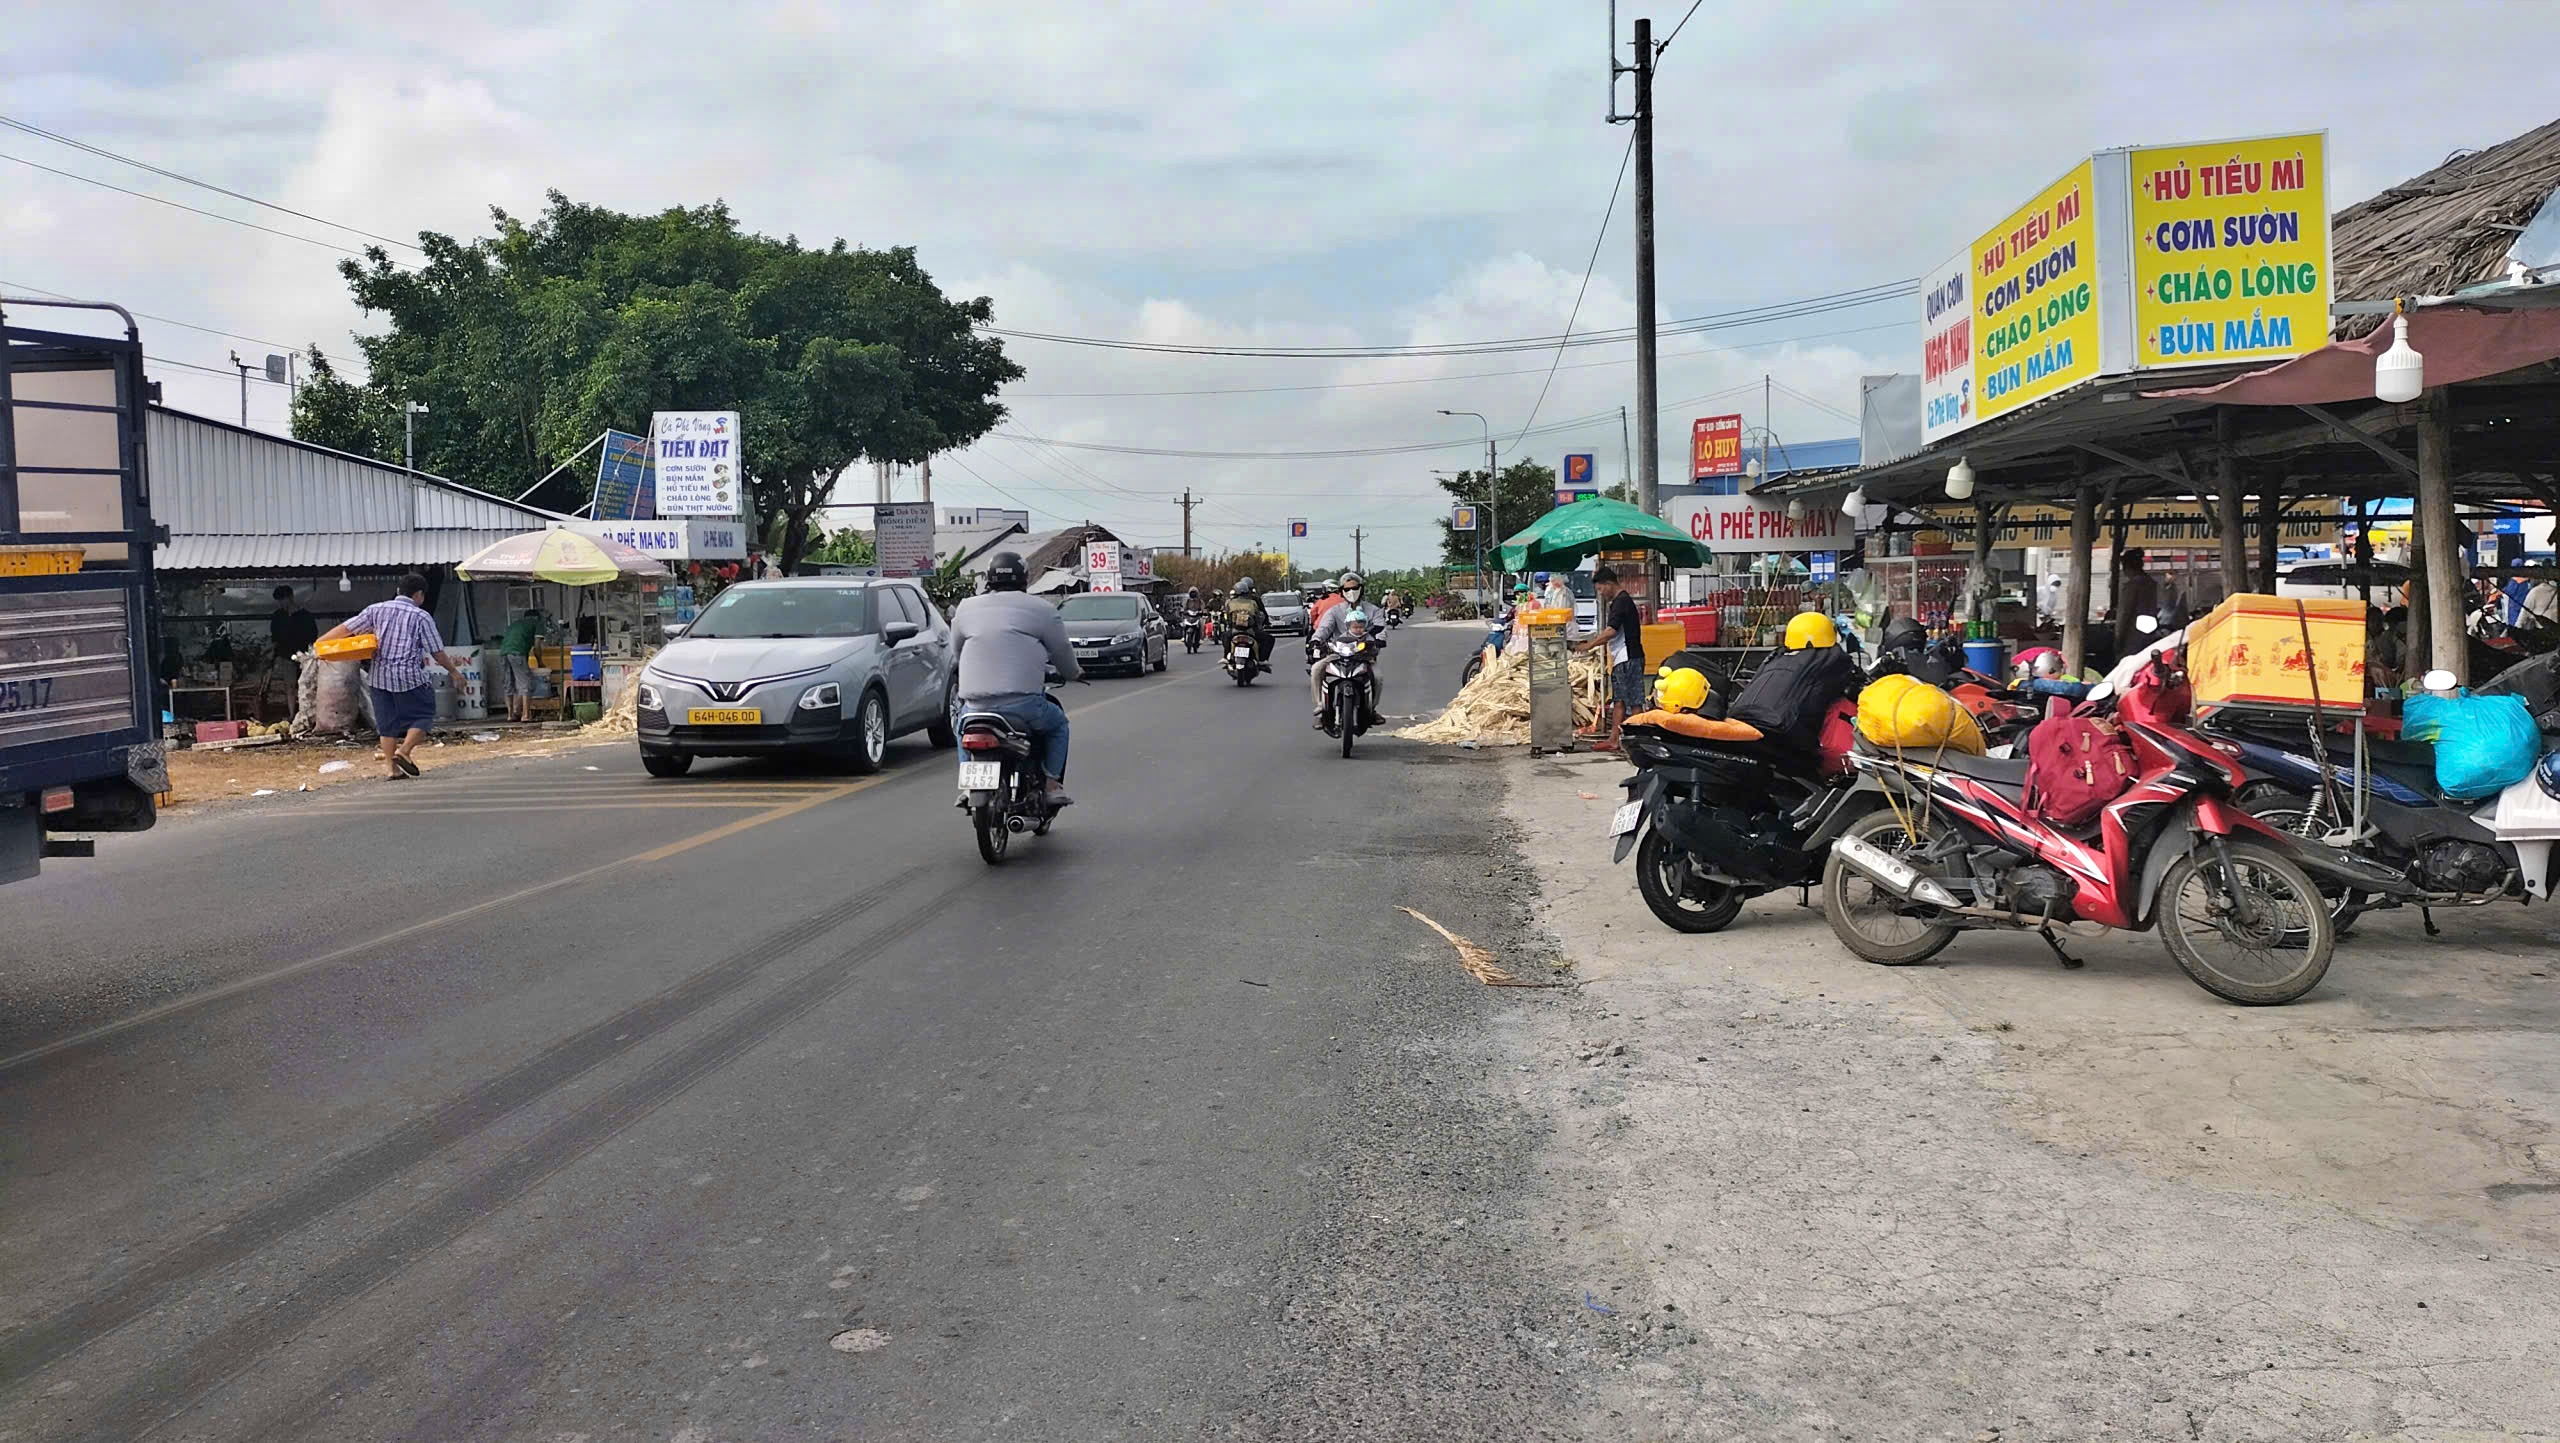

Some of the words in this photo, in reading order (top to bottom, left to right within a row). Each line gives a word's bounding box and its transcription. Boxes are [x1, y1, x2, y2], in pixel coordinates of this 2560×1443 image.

[2155, 160, 2191, 201] HỦ
[2200, 154, 2261, 197] TIẾU
[2271, 151, 2304, 191] MÌ
[1984, 235, 2006, 277] HỦ
[2010, 210, 2050, 258] TIẾU
[2056, 183, 2080, 230] MÌ
[2156, 218, 2216, 252] CƠM
[2223, 206, 2299, 248] SƯỜN
[1926, 281, 1946, 327] QUÁN
[1947, 272, 1964, 310] CƠM
[1985, 275, 2021, 317] CƠM
[2025, 240, 2076, 295] SƯỜN
[2158, 263, 2232, 304] CHÁO
[2241, 259, 2316, 298] LÒNG
[1986, 314, 2032, 358] CHÁO
[2037, 282, 2090, 334] LÒNG
[2160, 317, 2215, 355] BÚN
[2223, 307, 2292, 351] MẮM
[1925, 329, 1949, 386] NGỌC
[1987, 363, 2021, 401] BÚN
[2026, 339, 2073, 384] MẮM
[661, 433, 696, 458] TIẾN
[699, 440, 729, 461] ĐẠT
[665, 464, 683, 472] CƠM
[1714, 437, 1738, 458] HUY
[666, 493, 688, 502] CHÁO
[669, 532, 679, 549] ĐI
[1691, 506, 1714, 540] CÀ
[1720, 505, 1755, 540] PHÊ
[1759, 511, 1794, 539] PHA
[1800, 503, 1840, 537] MÁY
[1091, 552, 1107, 568] 39
[1138, 560, 1151, 575] 39
[965, 776, 993, 787] 2452
